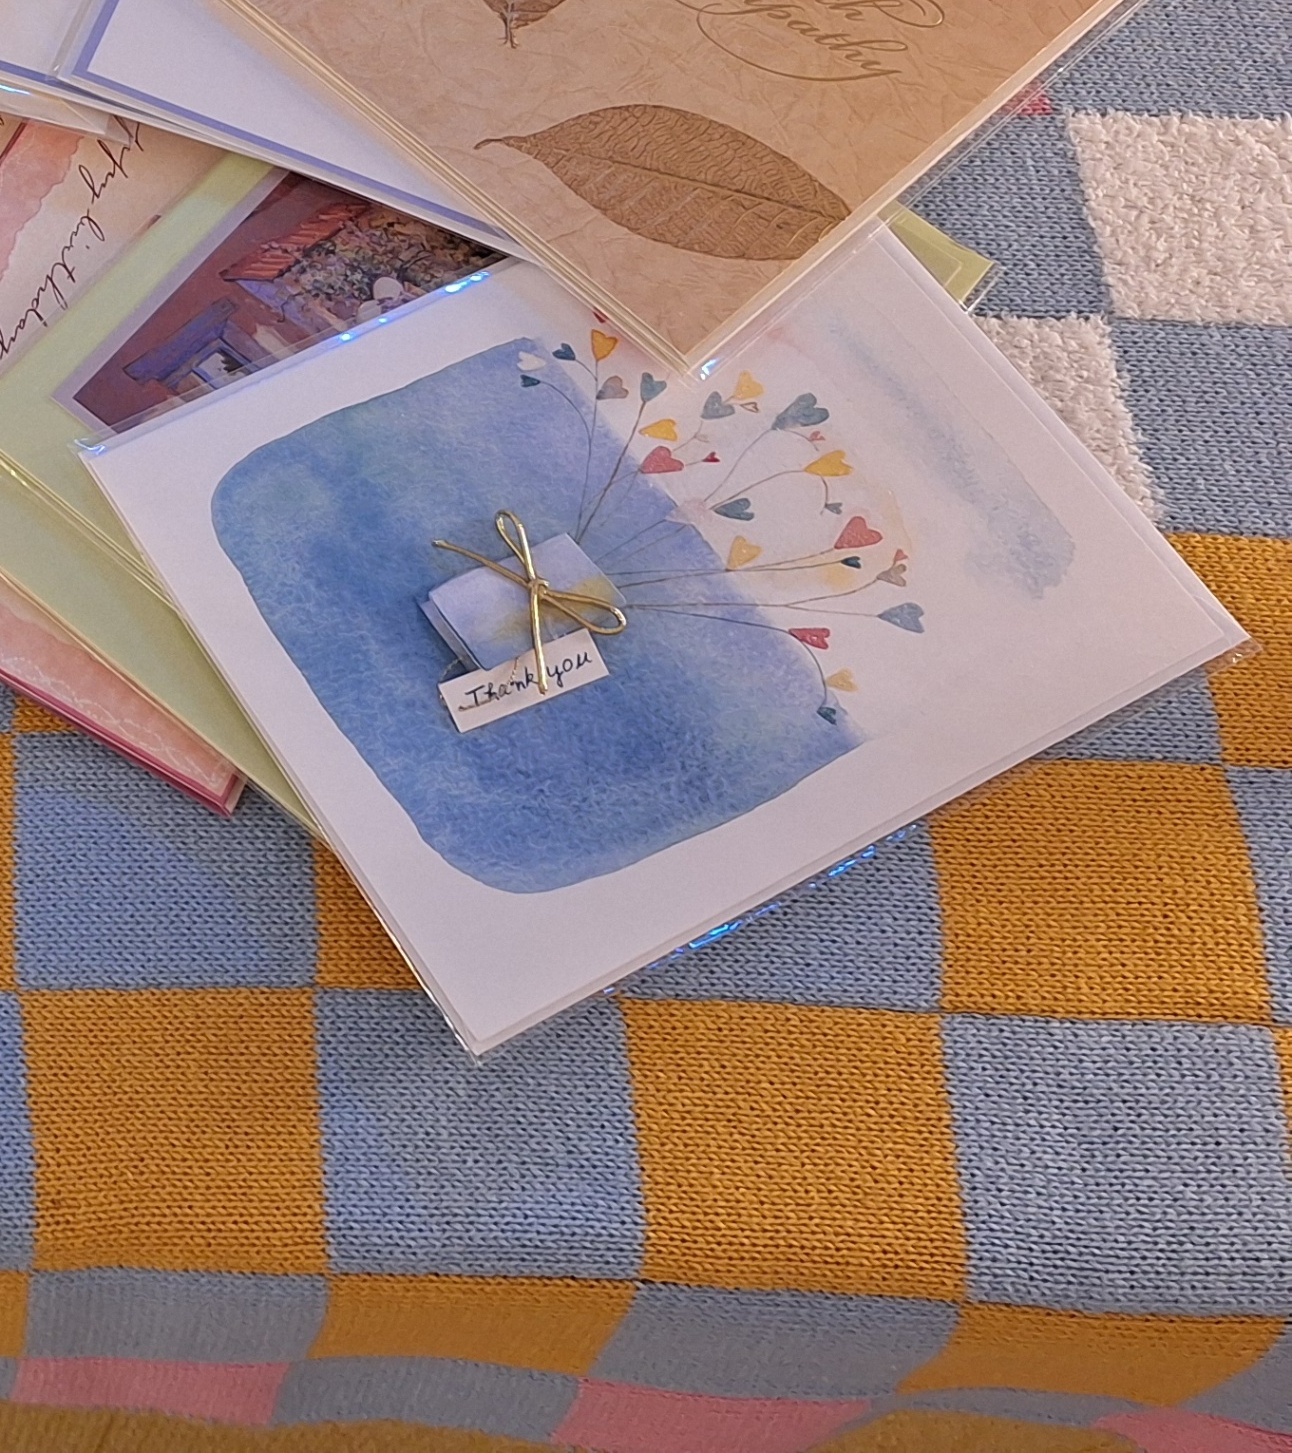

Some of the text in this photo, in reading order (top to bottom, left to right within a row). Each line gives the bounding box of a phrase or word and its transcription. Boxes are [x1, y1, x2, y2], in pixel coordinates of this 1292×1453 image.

[78, 113, 145, 204] ppy
[464, 651, 593, 707] Thank you
